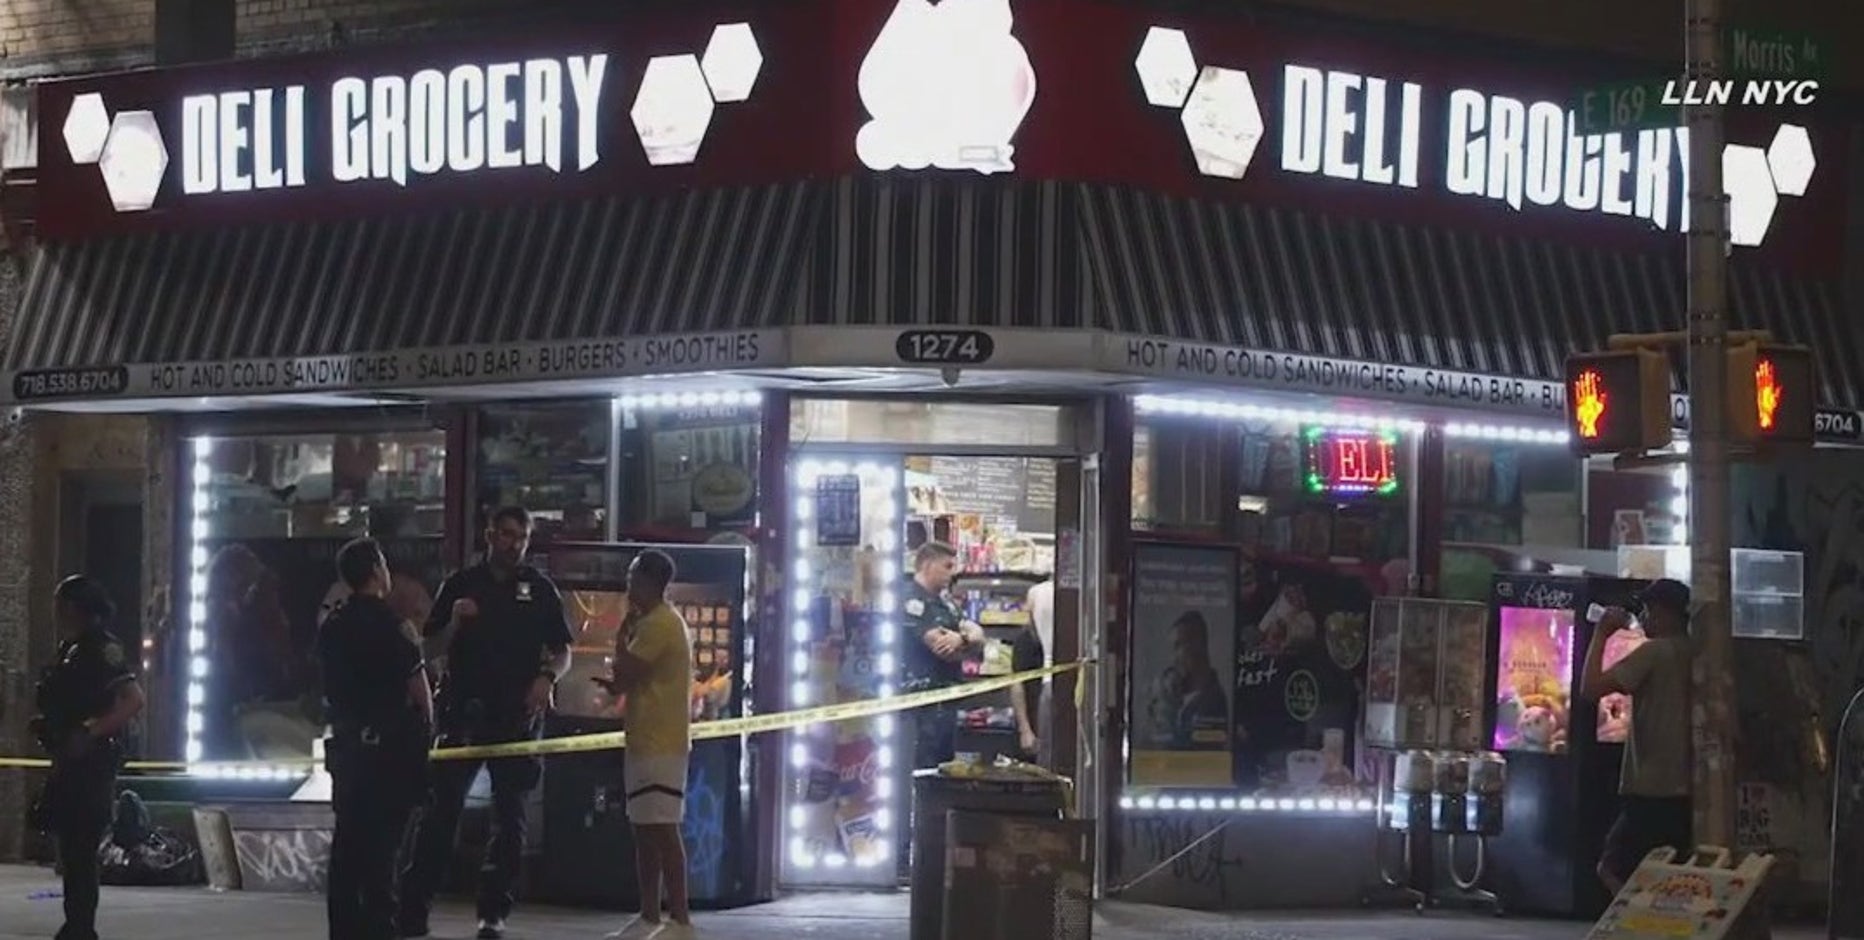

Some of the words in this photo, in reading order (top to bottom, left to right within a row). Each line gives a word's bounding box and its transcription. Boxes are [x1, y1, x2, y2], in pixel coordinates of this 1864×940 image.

[1733, 29, 1795, 74] Morris
[182, 86, 305, 194] DELI
[331, 54, 608, 187] GROCERY
[1281, 64, 1422, 188] DELI
[1583, 91, 1598, 129] E
[1608, 85, 1647, 127] 169
[150, 365, 185, 390] HOT
[191, 363, 225, 388] AND
[231, 362, 276, 387] COLD
[283, 354, 399, 386] SANDWICHES
[417, 350, 477, 380] SALAD
[482, 347, 521, 375] BAR
[539, 341, 626, 373] BURGERS
[645, 333, 760, 367] SMOOTHIES
[910, 333, 980, 360] 1274
[1128, 339, 1168, 368] HOT
[1175, 345, 1217, 375] AND
[1224, 350, 1277, 380] COLD
[1283, 356, 1407, 394] SANDWICHES
[1424, 371, 1484, 403] SALAD
[1490, 378, 1525, 406] BAR
[1541, 385, 1565, 411] BU
[1815, 413, 1854, 433] 6704
[1236, 657, 1279, 688] fast
